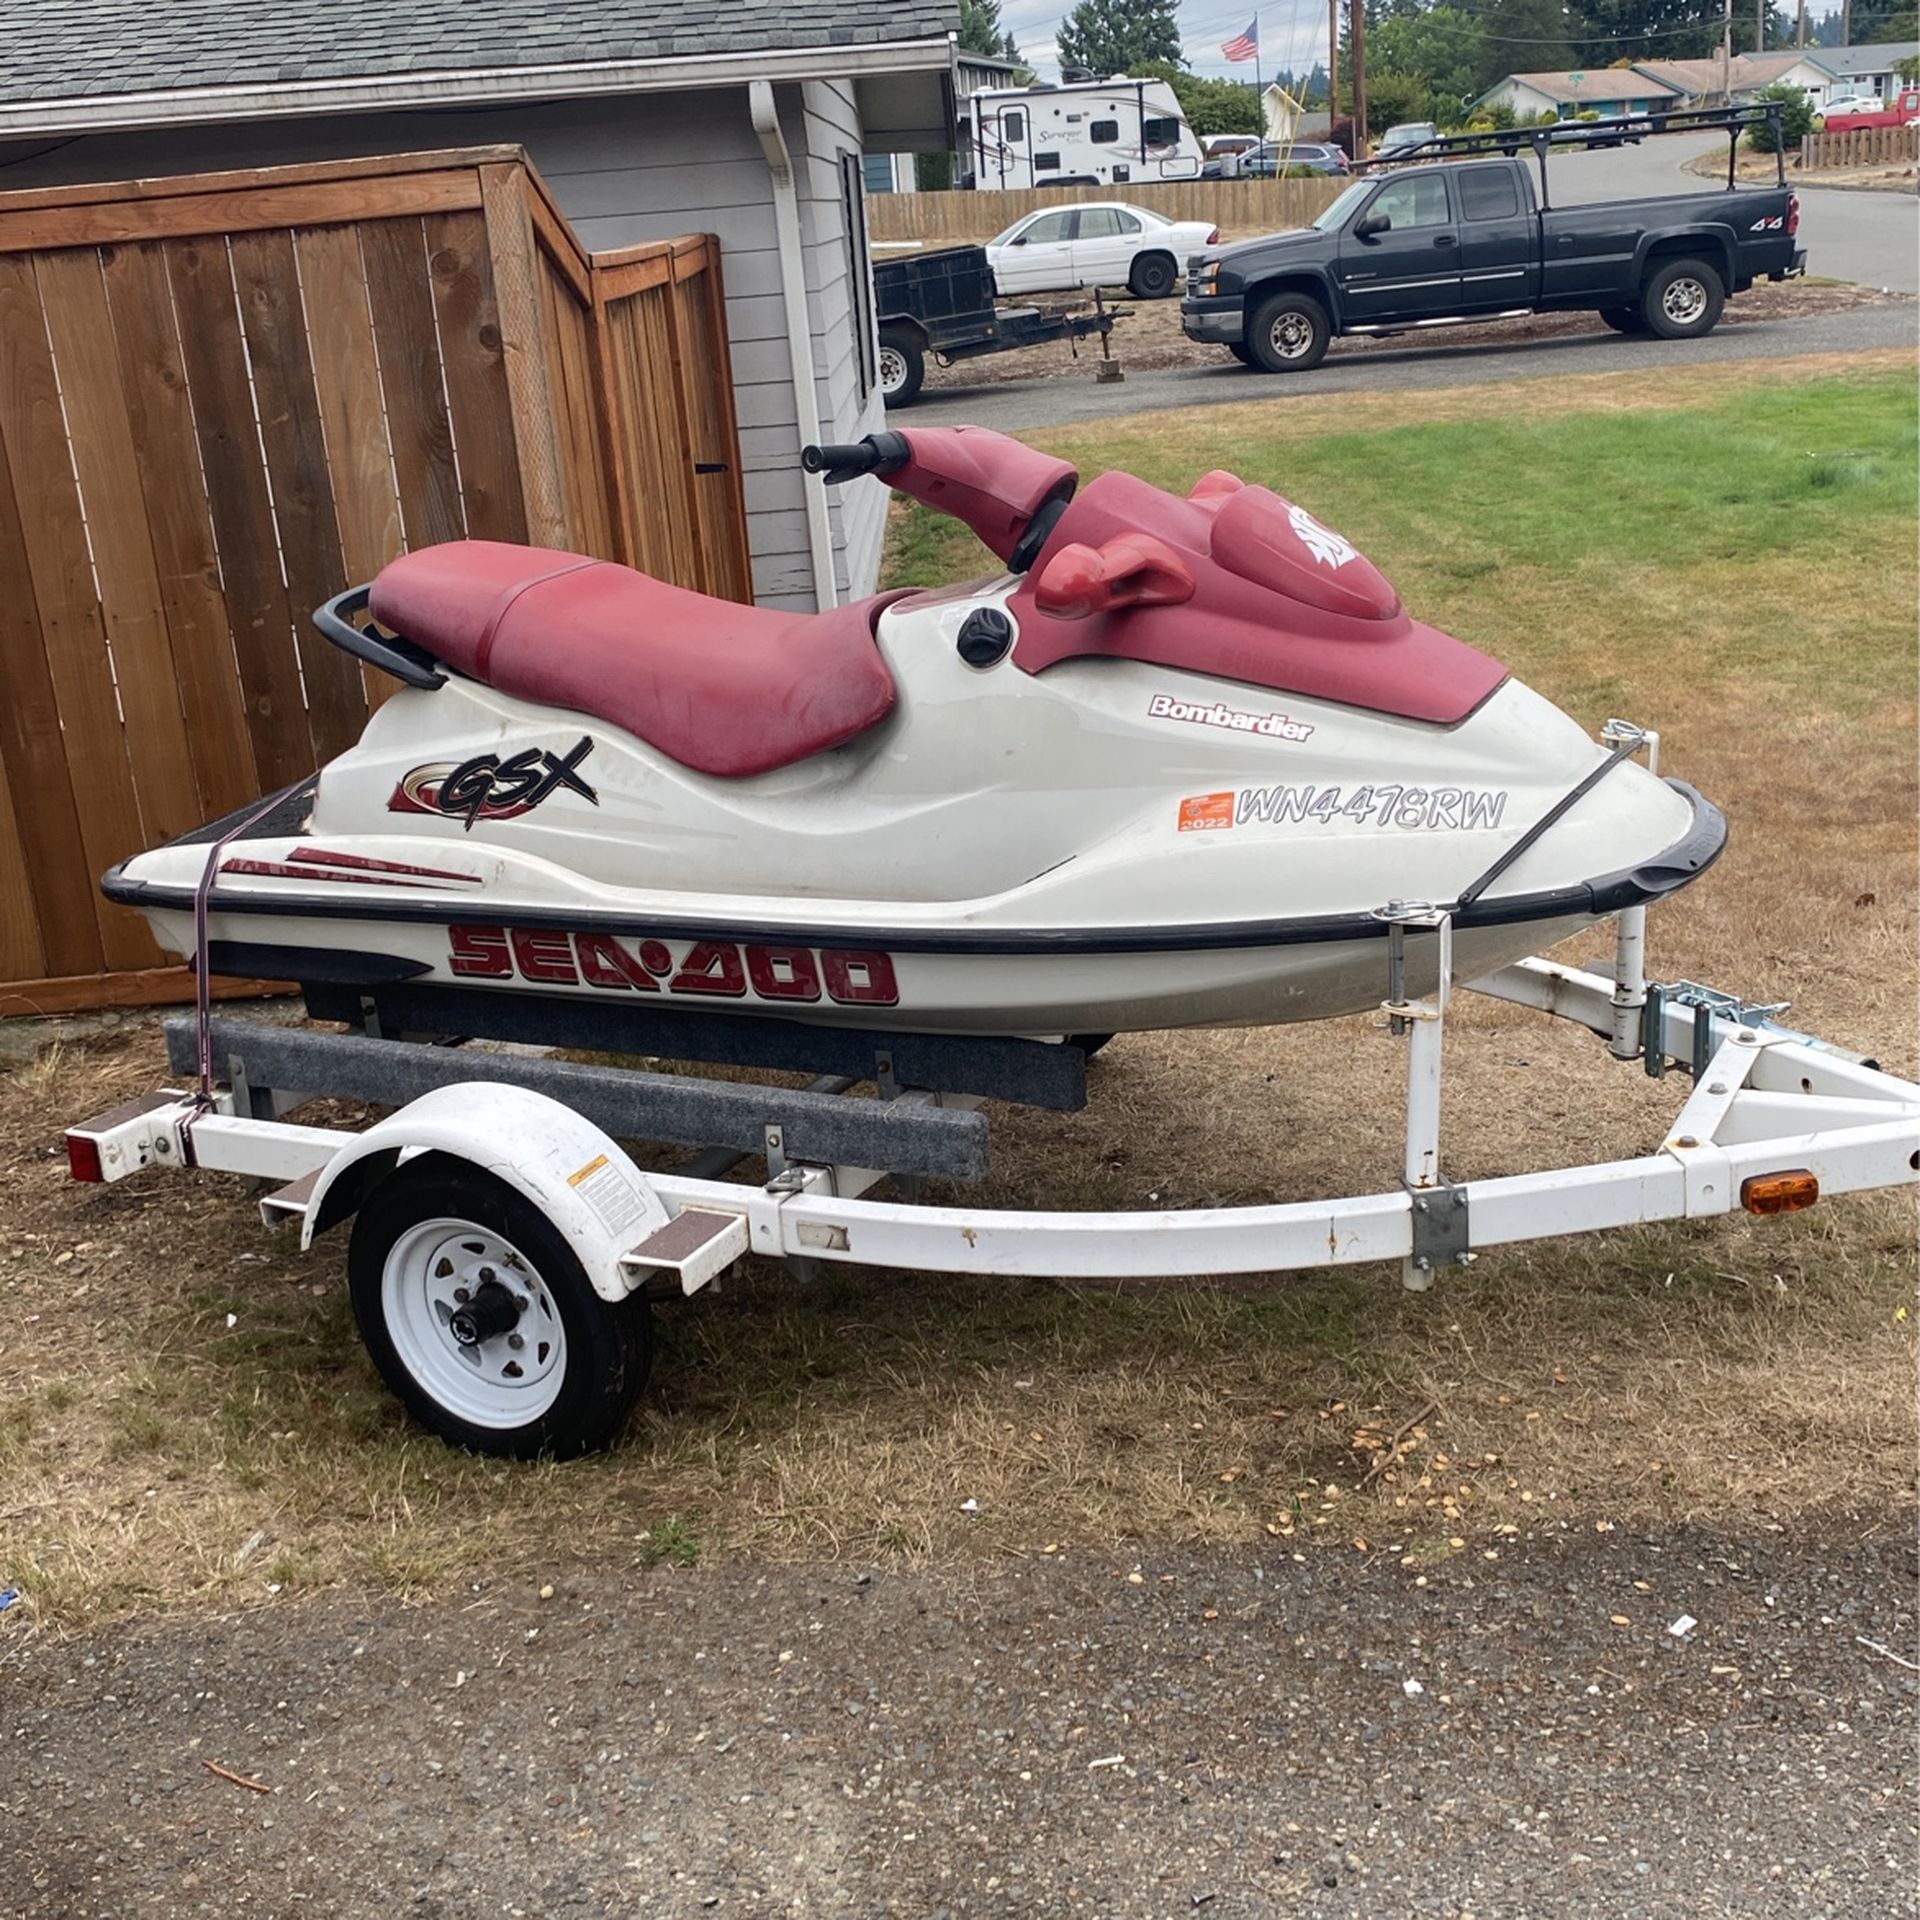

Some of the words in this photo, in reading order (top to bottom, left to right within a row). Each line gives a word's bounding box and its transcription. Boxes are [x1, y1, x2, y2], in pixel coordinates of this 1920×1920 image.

[1148, 694, 1315, 742] Bombardier
[438, 735, 599, 832] GSX
[1236, 784, 1508, 830] WN4478RW
[1180, 817, 1229, 831] 2022
